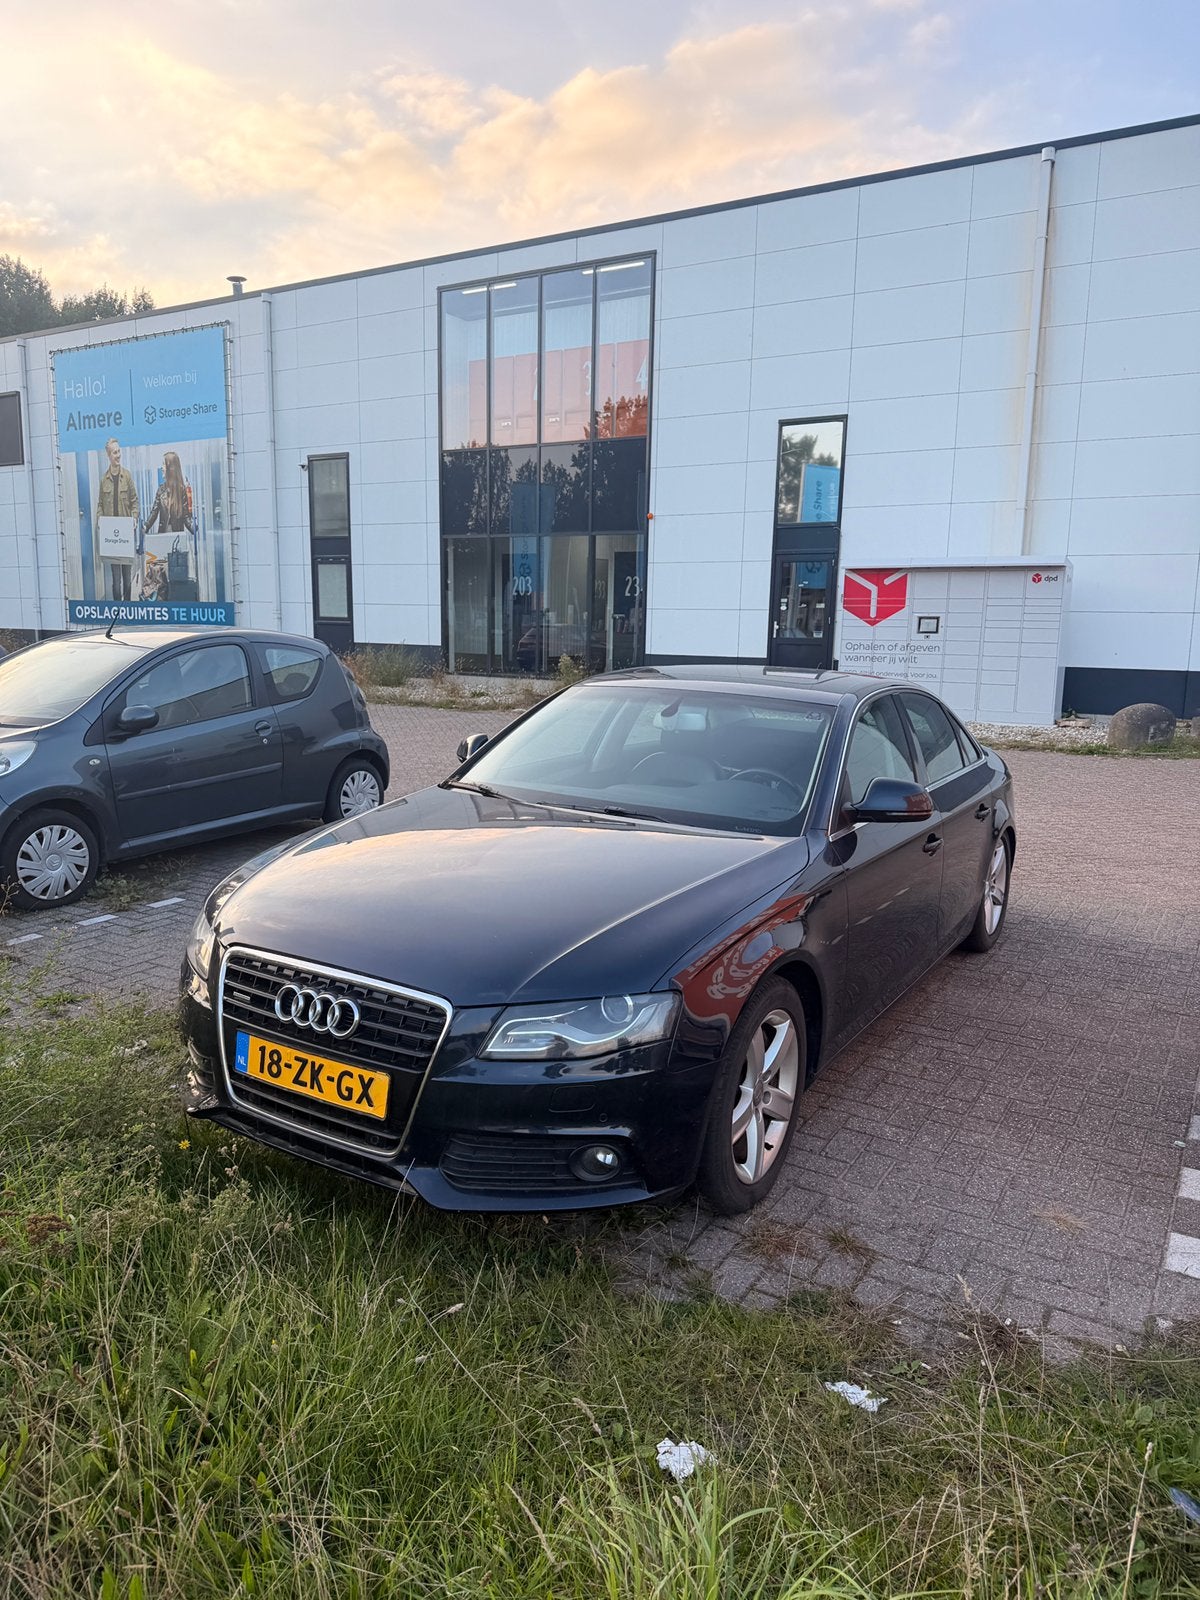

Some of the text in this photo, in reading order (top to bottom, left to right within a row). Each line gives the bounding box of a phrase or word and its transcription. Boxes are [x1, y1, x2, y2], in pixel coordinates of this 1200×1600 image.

[64, 375, 106, 399] Hallo!
[143, 371, 198, 388] Welkom bij
[159, 402, 217, 419] Storage Share
[66, 410, 122, 431] Almere
[512, 576, 532, 596] 203
[1044, 574, 1058, 583] dpd
[75, 605, 226, 622] OPSLAGRUIMTES TE HUUR
[845, 641, 940, 653] Ophalen of afgeven
[844, 653, 918, 665] wanneer jij wilt
[237, 1054, 247, 1067] NL
[258, 1045, 375, 1108] 18-ZK-GX
